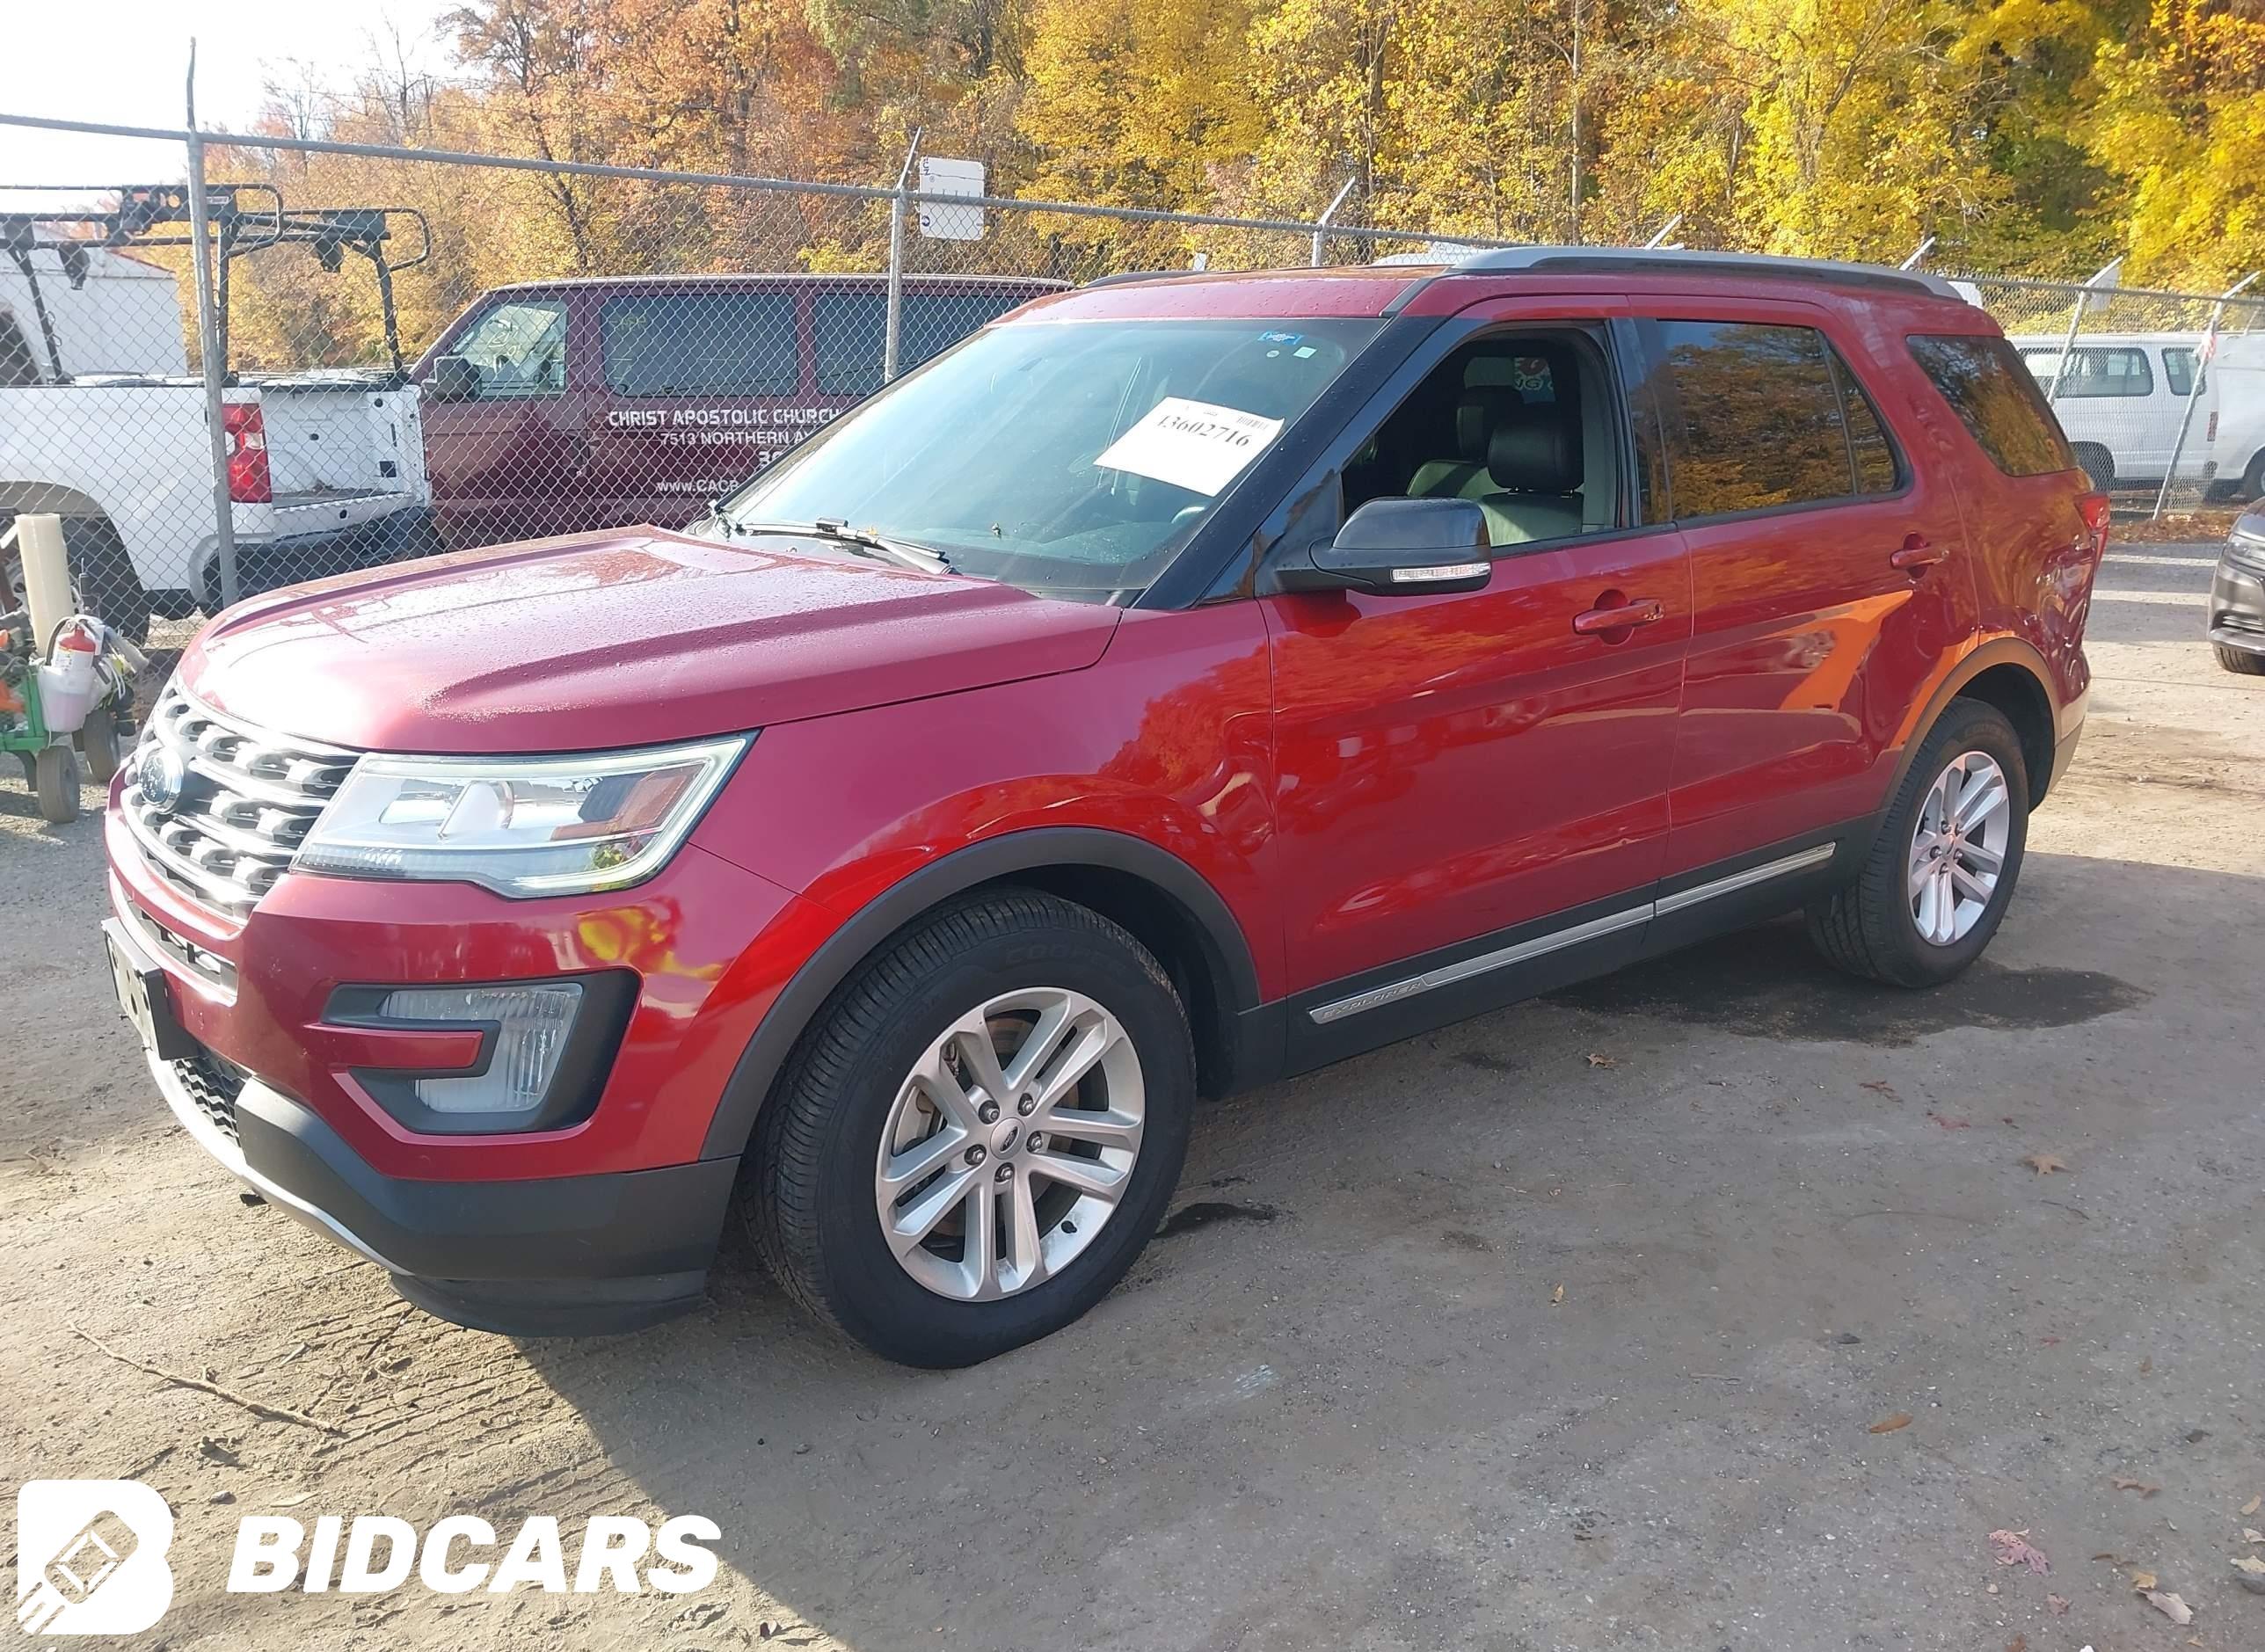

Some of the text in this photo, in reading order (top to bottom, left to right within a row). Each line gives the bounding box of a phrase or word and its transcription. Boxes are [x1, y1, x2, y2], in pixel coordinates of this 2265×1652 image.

[608, 408, 840, 426] CHRIST APOSTOLIC CHURCH
[660, 432, 696, 446] 7513
[700, 431, 790, 445] NORTHERN
[1156, 414, 1252, 447] 13602716
